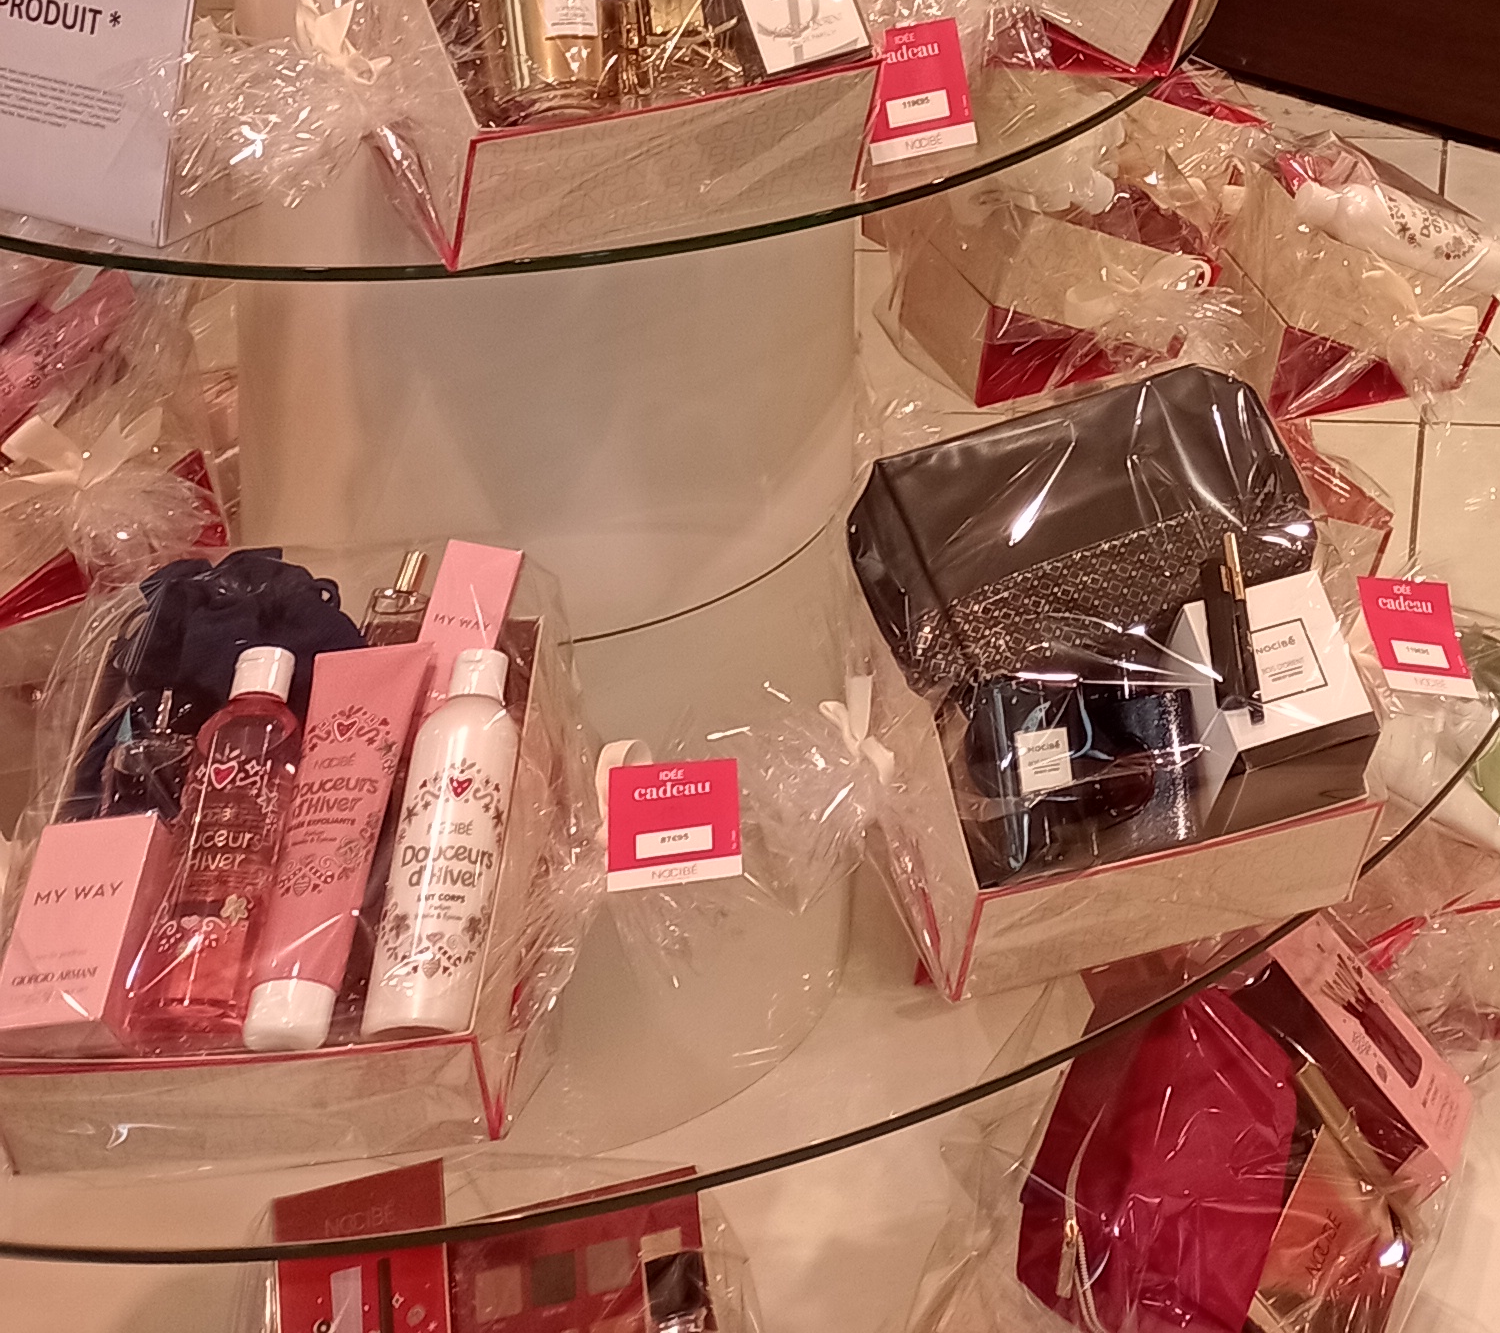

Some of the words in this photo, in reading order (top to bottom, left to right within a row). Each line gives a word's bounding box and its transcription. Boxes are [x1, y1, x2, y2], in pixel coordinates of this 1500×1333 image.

[893, 32, 916, 45] IDÉE
[886, 42, 940, 65] adeau
[905, 132, 944, 151] NOCIBÉ
[1377, 595, 1433, 614] cadeau
[433, 613, 456, 626] MY
[459, 617, 491, 632] WAY
[1255, 635, 1296, 655] NOCIBÉ
[1027, 739, 1061, 753] NOCIBÉ
[313, 752, 357, 770] NOCIBÉ
[659, 768, 685, 781] IDÉE
[633, 781, 711, 801] cadeau
[191, 829, 263, 851] uceurs
[401, 844, 494, 870] Douceurs
[651, 863, 698, 880] NOCIBÉ
[34, 887, 68, 907] MY
[74, 880, 124, 902] WAY
[438, 893, 466, 904] CORPS
[12, 968, 56, 987] GIORGIO
[56, 965, 98, 982] ARMANI
